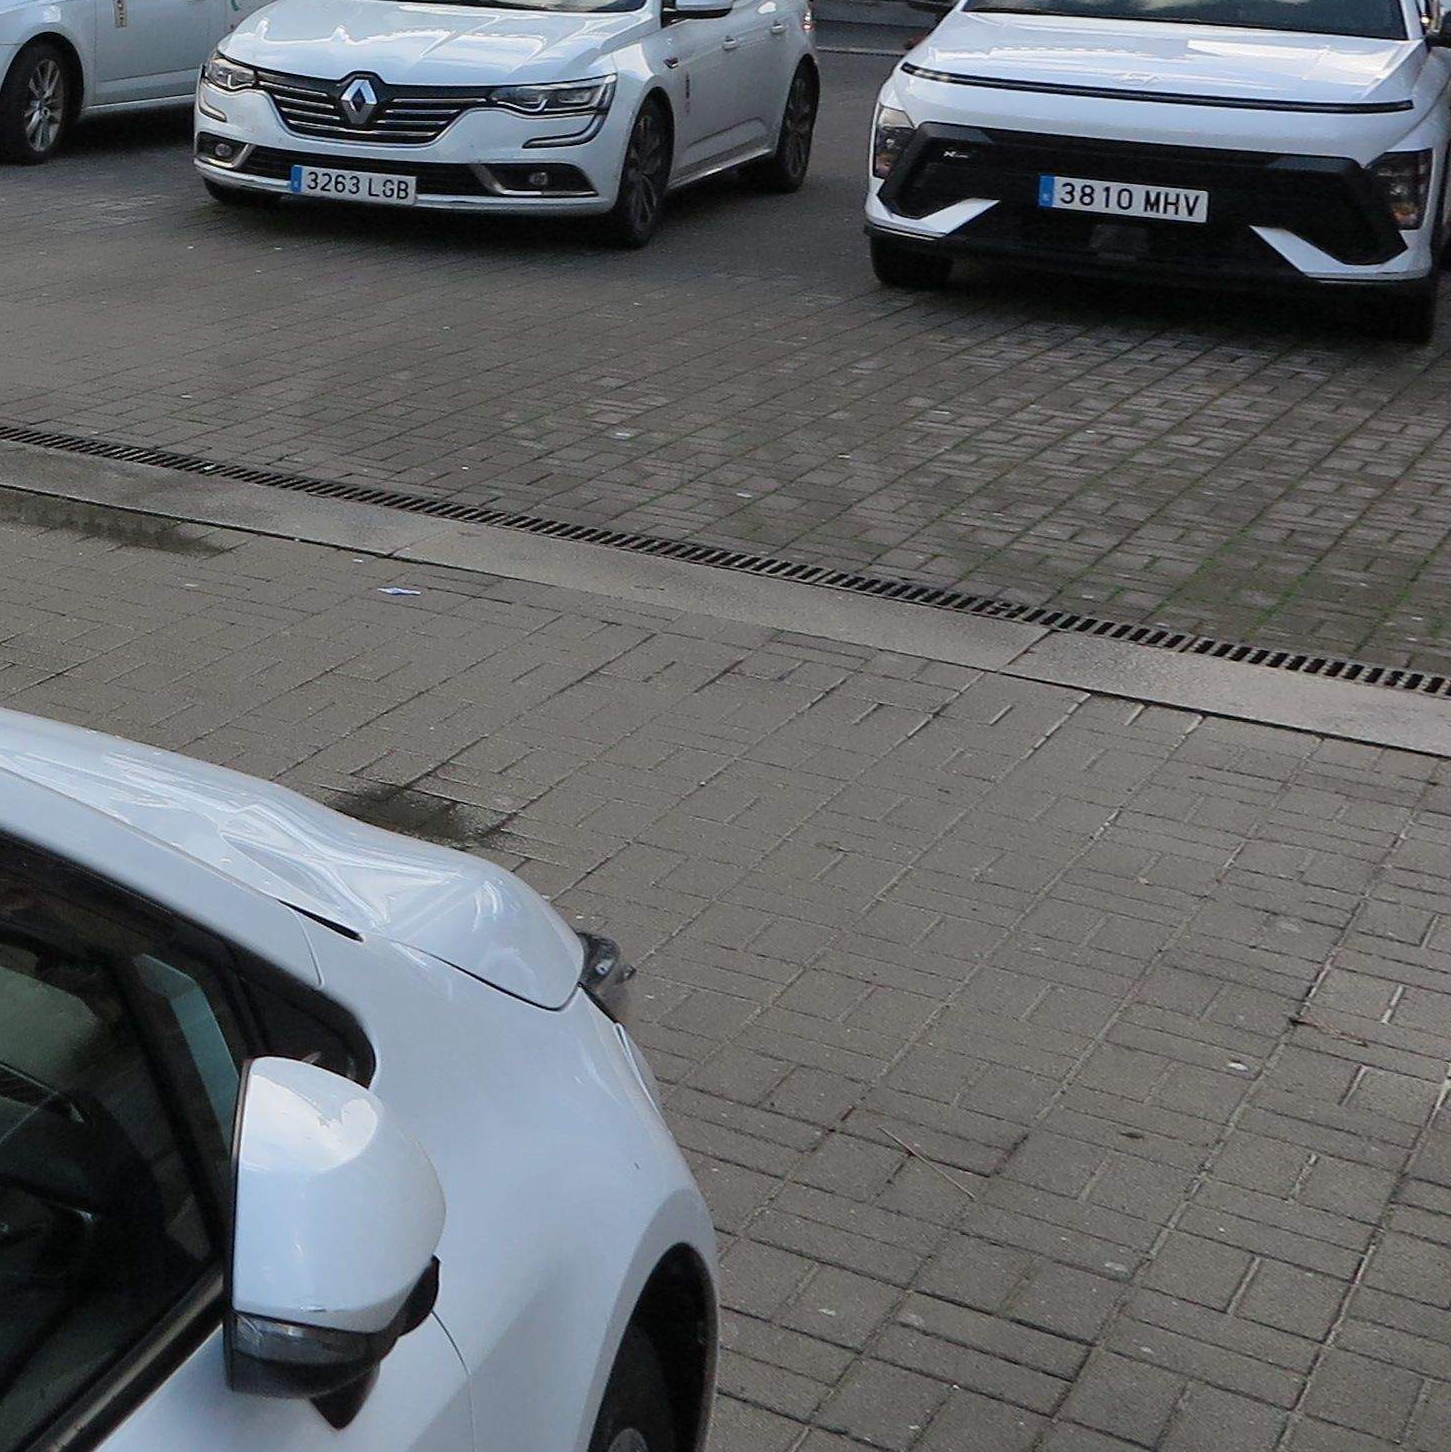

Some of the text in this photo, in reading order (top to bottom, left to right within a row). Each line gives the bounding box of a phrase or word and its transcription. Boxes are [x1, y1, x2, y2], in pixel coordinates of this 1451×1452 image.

[306, 171, 410, 200] 3263 LGB
[1060, 182, 1201, 217] 3810 MHV
